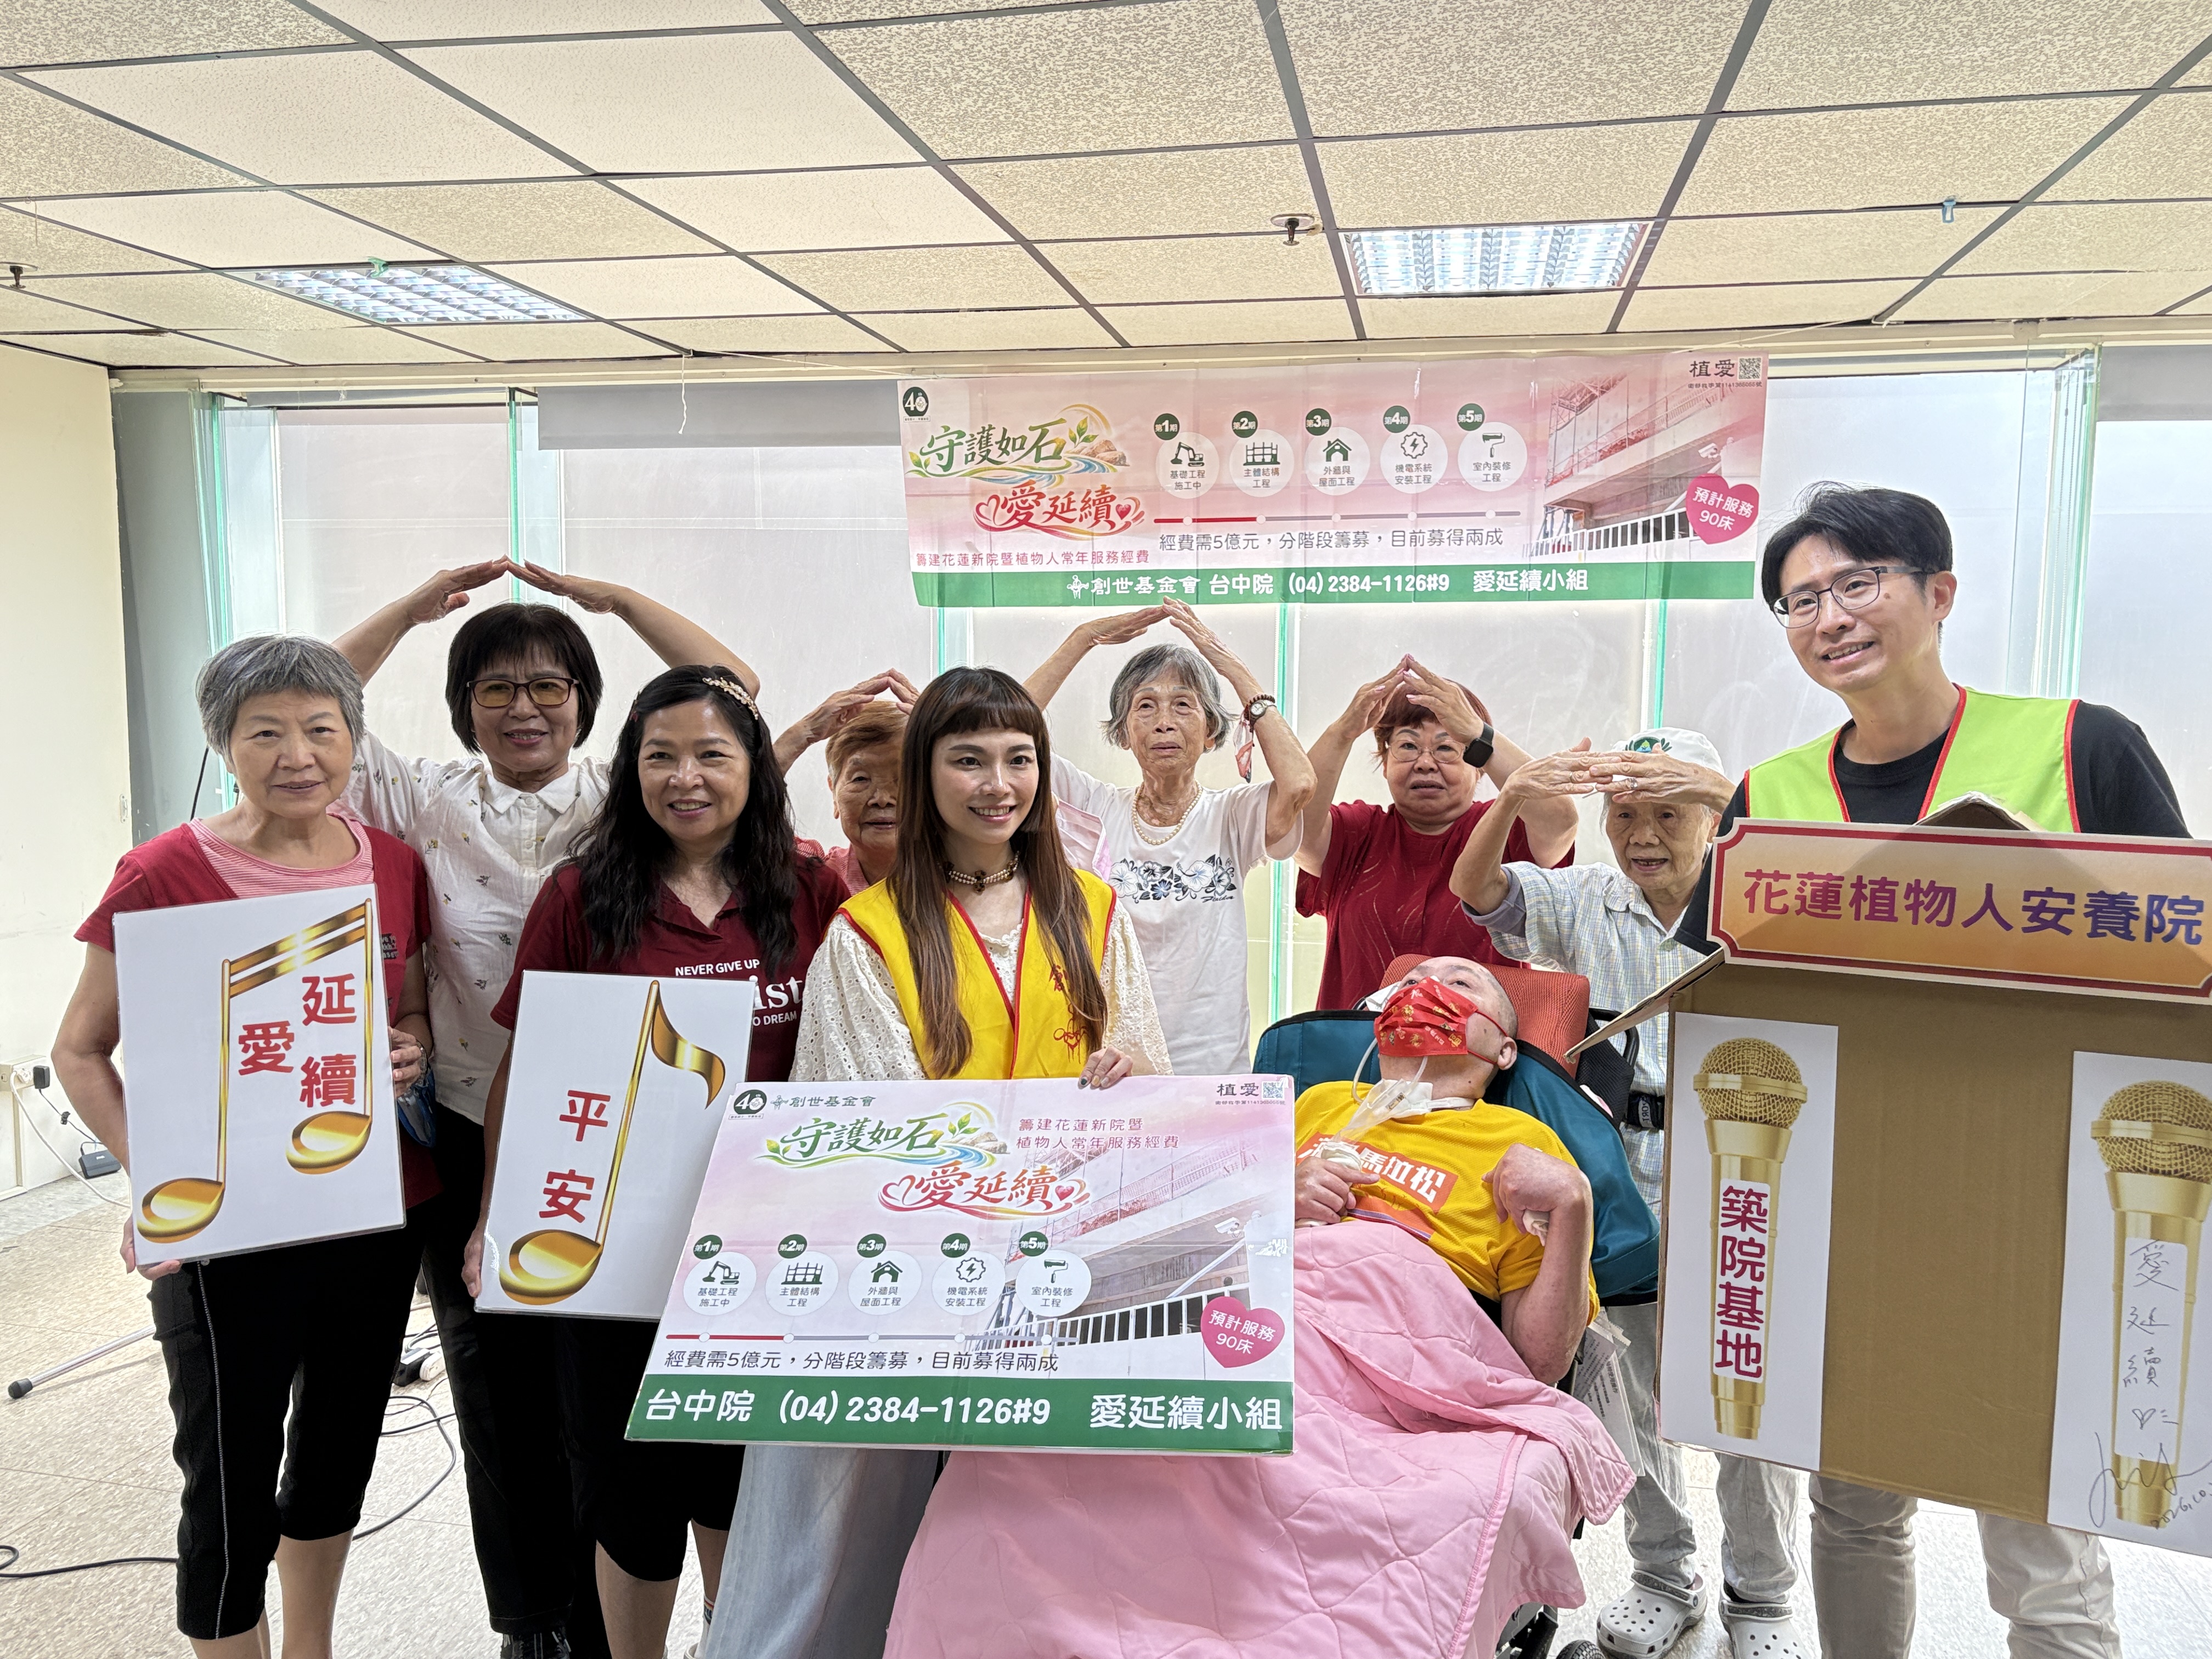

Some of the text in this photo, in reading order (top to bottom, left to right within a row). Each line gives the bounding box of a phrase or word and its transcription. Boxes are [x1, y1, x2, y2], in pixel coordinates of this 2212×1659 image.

[1689, 359, 1735, 377] 植愛
[1233, 417, 1256, 430] 第2期
[1306, 415, 1329, 427] 第3期
[1385, 412, 1408, 425] 第4期
[1458, 410, 1482, 423] 第5期
[1155, 420, 1178, 432] 第1期
[920, 418, 1067, 472] 守護如石
[1170, 470, 1206, 479] 基礎工程
[1243, 467, 1280, 477] 主體結構
[1395, 464, 1432, 473] 機電系統
[1252, 479, 1271, 488] 工程
[1318, 477, 1355, 487] 屋面工程
[1395, 475, 1432, 485] 安裝工程
[1482, 473, 1502, 483] 工程
[1175, 481, 1201, 490] 施工中
[1001, 480, 1117, 531] 愛延續
[1692, 486, 1754, 518] 預計服務
[1699, 510, 1735, 532] 90床
[916, 550, 1150, 566] 籌建花蓮新院暨植物人常年服務經費
[1090, 569, 1588, 595] 創世基金會 台中院 (04) 2384-1126#9 愛延續小組
[1744, 868, 2205, 945] 花蓮植物人安養院
[675, 959, 760, 976] NEVER GIVE UP
[749, 975, 803, 1010] ist
[764, 1011, 797, 1025] DREAM
[238, 1020, 295, 1075] 愛
[299, 973, 358, 1108] 延續
[1216, 1082, 1259, 1096] 植愛
[789, 1096, 877, 1107] 創世基金會
[1019, 1118, 1144, 1132] 籌建花蓮新院暨
[780, 1113, 950, 1158] 守護如石
[1016, 1135, 1180, 1150] 植物人常年服務經費
[539, 1090, 611, 1223] 平安
[917, 1160, 1059, 1211] 愛延續
[693, 1239, 721, 1254] 第1期
[779, 1238, 805, 1253] 第2期
[858, 1238, 884, 1252] 第3期
[941, 1238, 968, 1252] 第4期
[1019, 1237, 1046, 1251] 第5期
[1715, 1186, 1769, 1379] 築院基地
[697, 1287, 738, 1297] 基礎工程
[779, 1286, 820, 1297] 主體結構
[867, 1286, 898, 1297] 外牆與
[947, 1286, 988, 1296] 機電系統
[1031, 1286, 1073, 1297] 室內裝修
[699, 1297, 730, 1307] 施工中
[787, 1297, 808, 1307] 工程
[860, 1297, 901, 1307] 屋面工程
[945, 1297, 986, 1307] 安裝工程
[1040, 1297, 1062, 1308] 工程
[2123, 1239, 2179, 1387] 愛延續
[1208, 1310, 1276, 1342] 預計服務
[1215, 1333, 1254, 1355] 90床
[645, 1389, 1283, 1430] 台中院 (04) 2384-1126#9 愛延續小組
